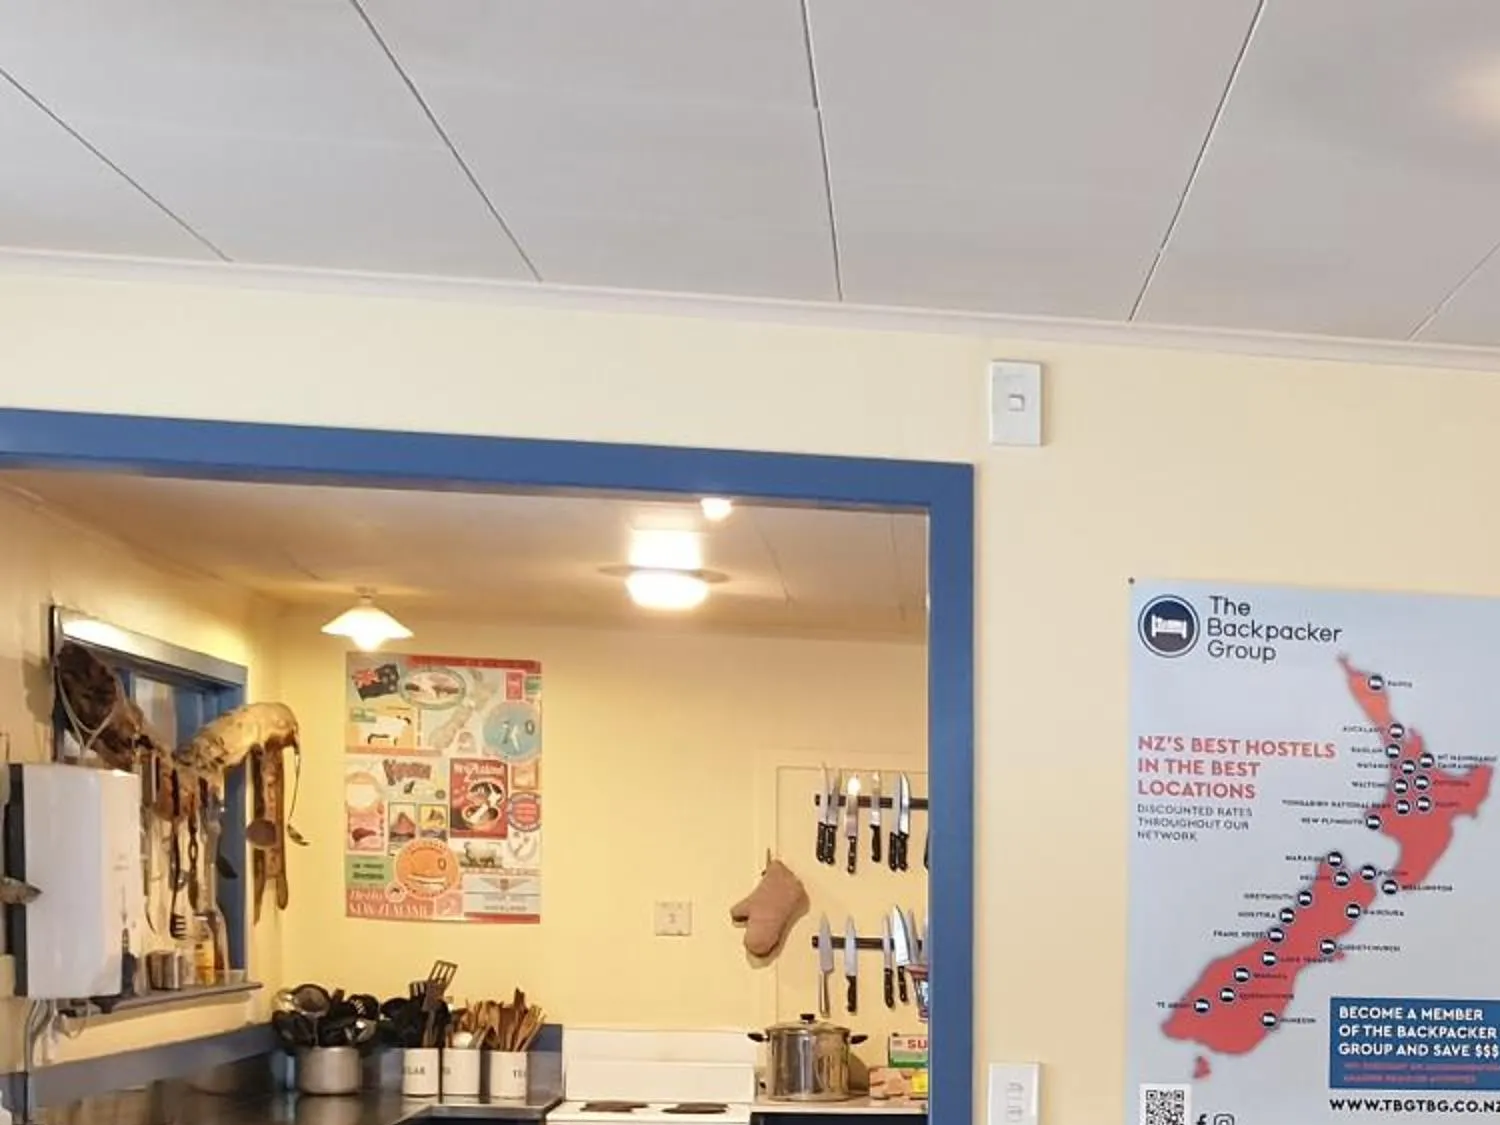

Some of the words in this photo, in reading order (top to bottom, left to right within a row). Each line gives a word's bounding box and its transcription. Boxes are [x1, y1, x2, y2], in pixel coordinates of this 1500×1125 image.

[1210, 595, 1251, 617] The
[1207, 618, 1343, 643] Backpacker
[1207, 640, 1277, 663] Group
[1137, 735, 1185, 752] NZ'S
[1191, 737, 1241, 754] BEST
[1246, 740, 1336, 758] HOSTELS
[1137, 758, 1159, 773] IN
[1164, 759, 1205, 775] THE
[1211, 760, 1261, 777] BEST
[1137, 780, 1256, 799] LOCATIONS
[1137, 804, 1214, 816] DISCOUNTED
[1217, 806, 1253, 818] RATES
[1137, 818, 1221, 830] THROUGHOUT
[1224, 820, 1249, 830] OUR
[1137, 831, 1197, 842] NETWORK
[1339, 1006, 1403, 1020] BECOME
[1407, 1008, 1417, 1019] A
[1421, 1008, 1483, 1021] MEMBER
[1339, 1024, 1362, 1037] OF
[1363, 1025, 1392, 1038] THE
[1397, 1026, 1497, 1039] BACKPACKER
[1339, 1042, 1393, 1056] GROUP
[1396, 1043, 1429, 1056] AND
[1433, 1044, 1470, 1057] SAVE
[1475, 1044, 1500, 1059] $$$
